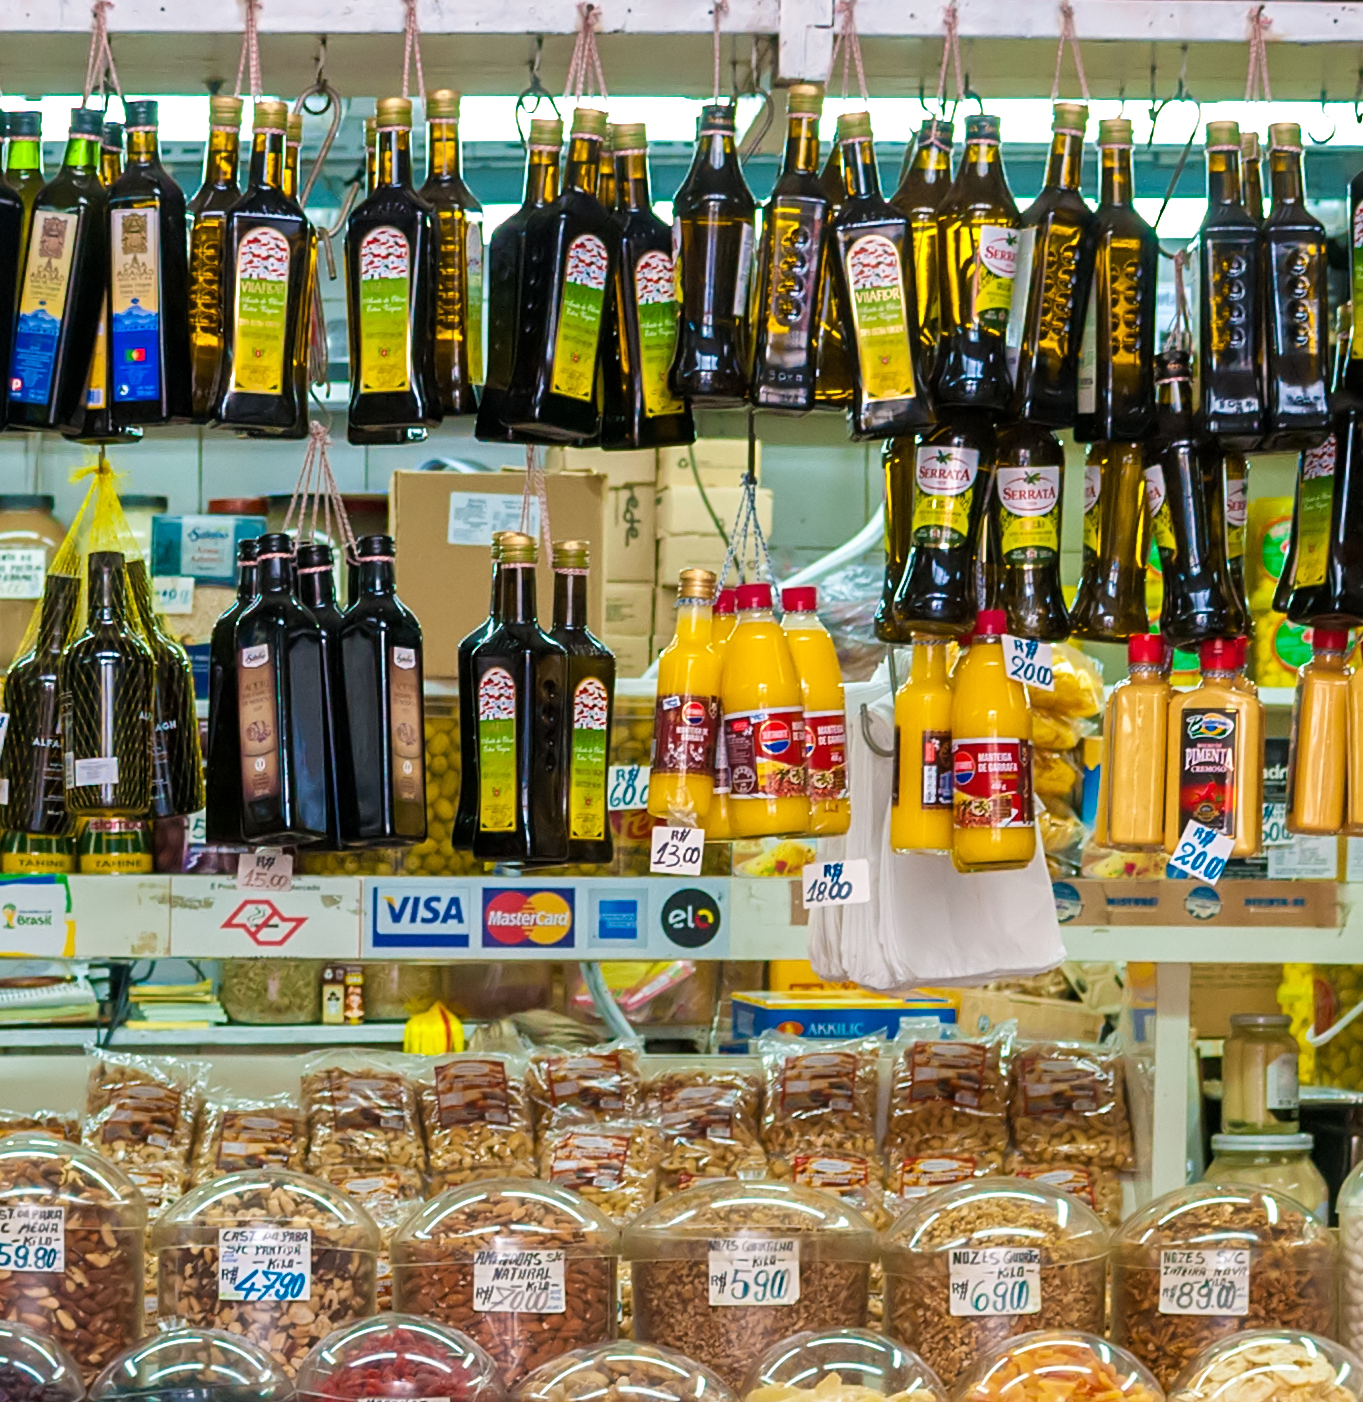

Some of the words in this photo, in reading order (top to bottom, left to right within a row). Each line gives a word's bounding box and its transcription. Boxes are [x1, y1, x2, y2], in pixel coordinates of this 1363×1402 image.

[919, 467, 970, 481] SERRATA
[1003, 488, 1056, 500] SERRATA
[1185, 748, 1234, 767] PIMENTA
[383, 896, 465, 924] VISA
[669, 905, 714, 929] elo
[488, 911, 569, 927] MasterCard
[807, 1021, 863, 1036] AKKILIC
